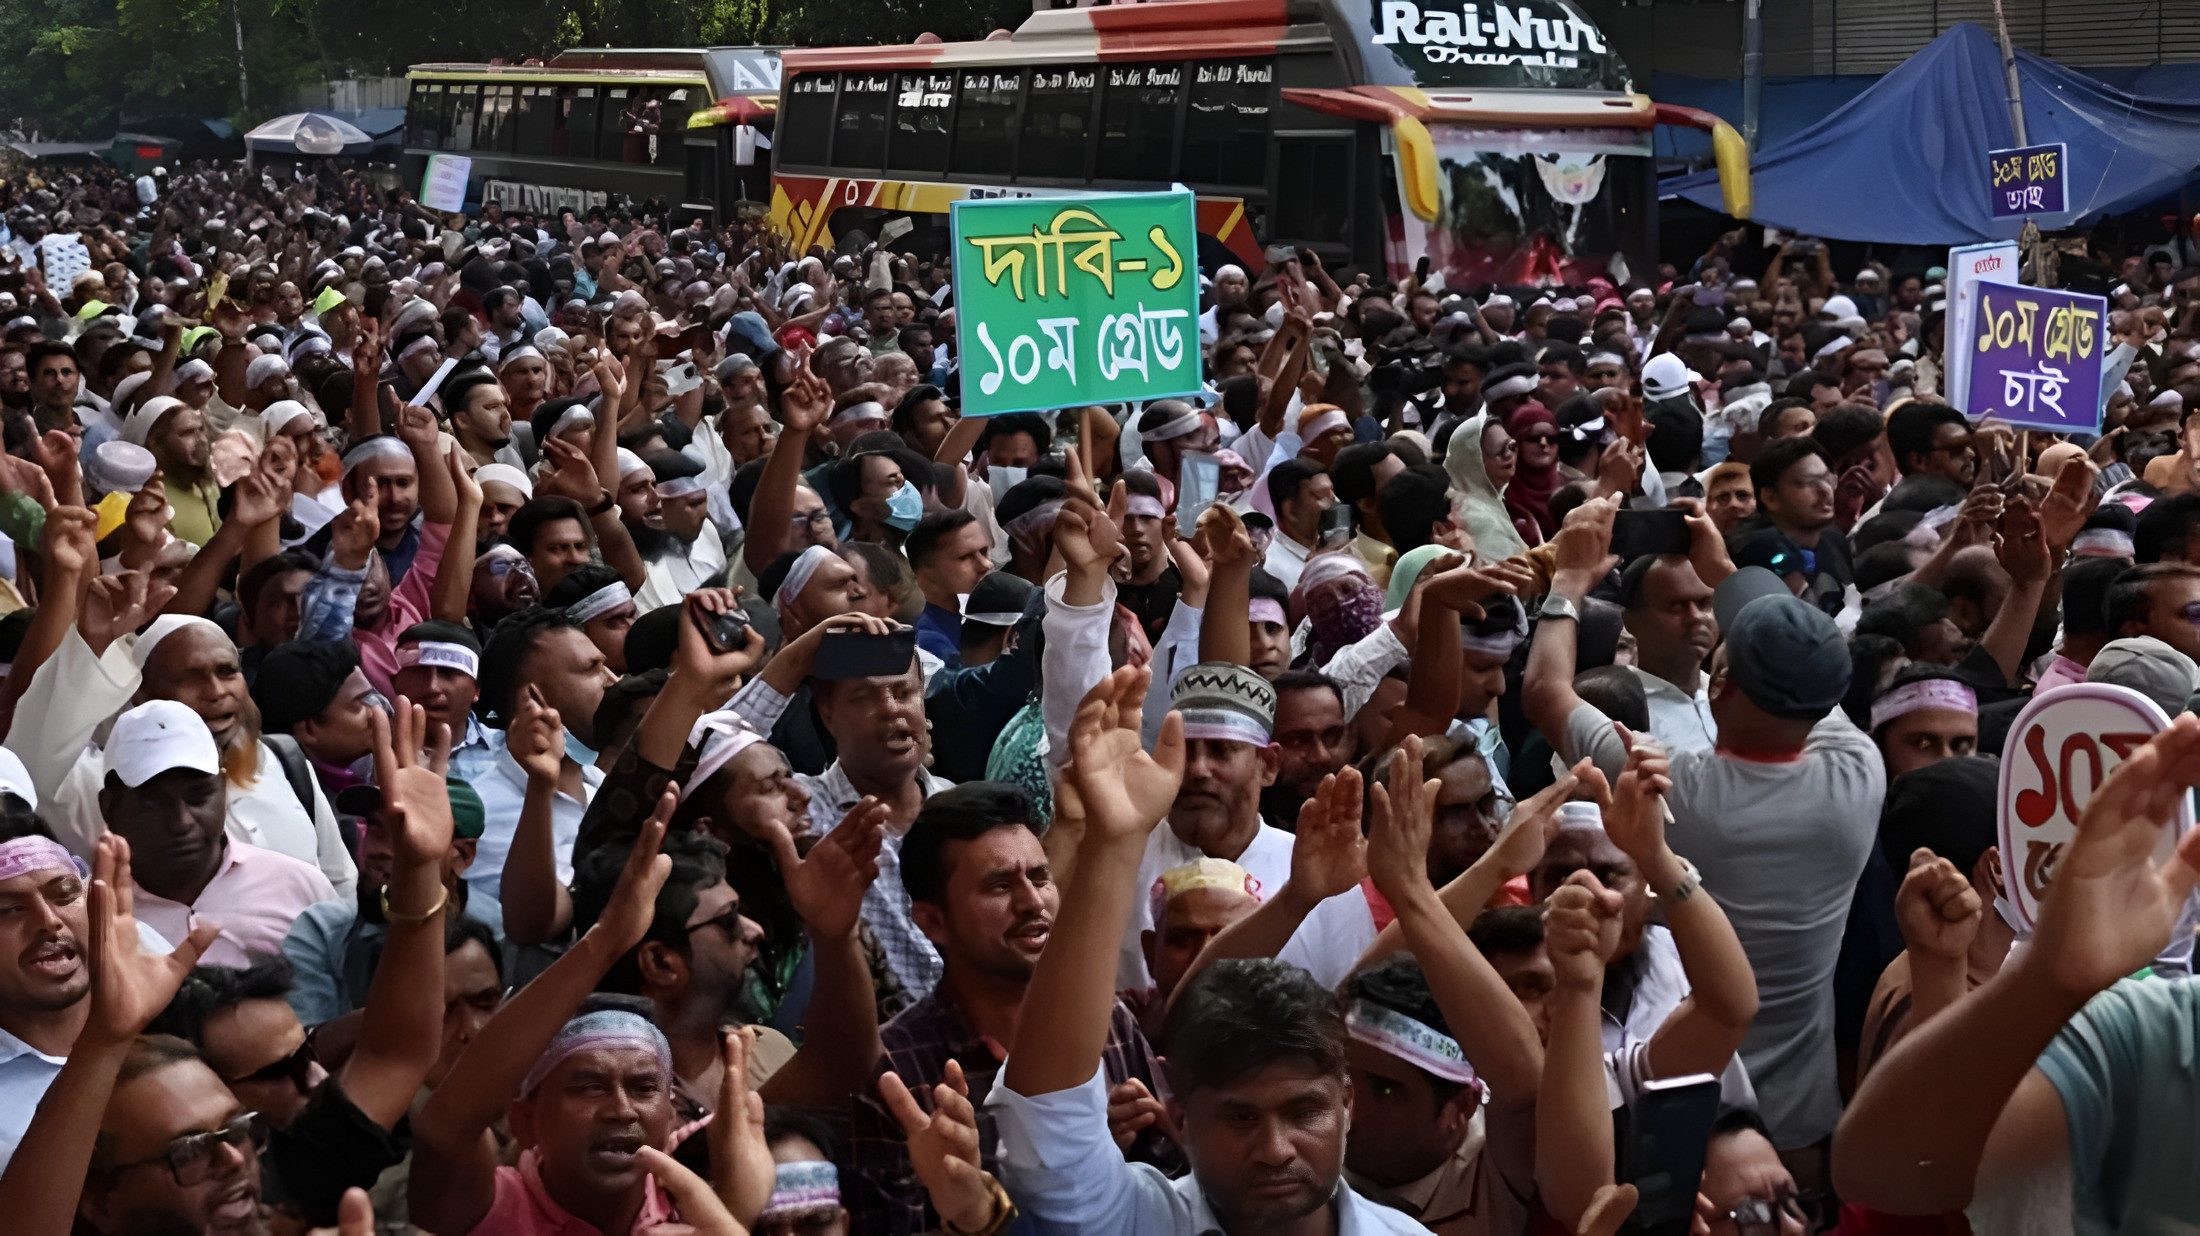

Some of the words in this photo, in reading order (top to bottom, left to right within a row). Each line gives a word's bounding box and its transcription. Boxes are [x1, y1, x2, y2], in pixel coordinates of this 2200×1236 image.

[966, 208, 1184, 301] দাবি-১
[977, 321, 1080, 395] ১০ম
[1098, 301, 1189, 383] গ্রেড
[1979, 295, 2039, 357] ১০ম
[2044, 301, 2098, 364] গ্রেড
[1999, 360, 2069, 417] চাই
